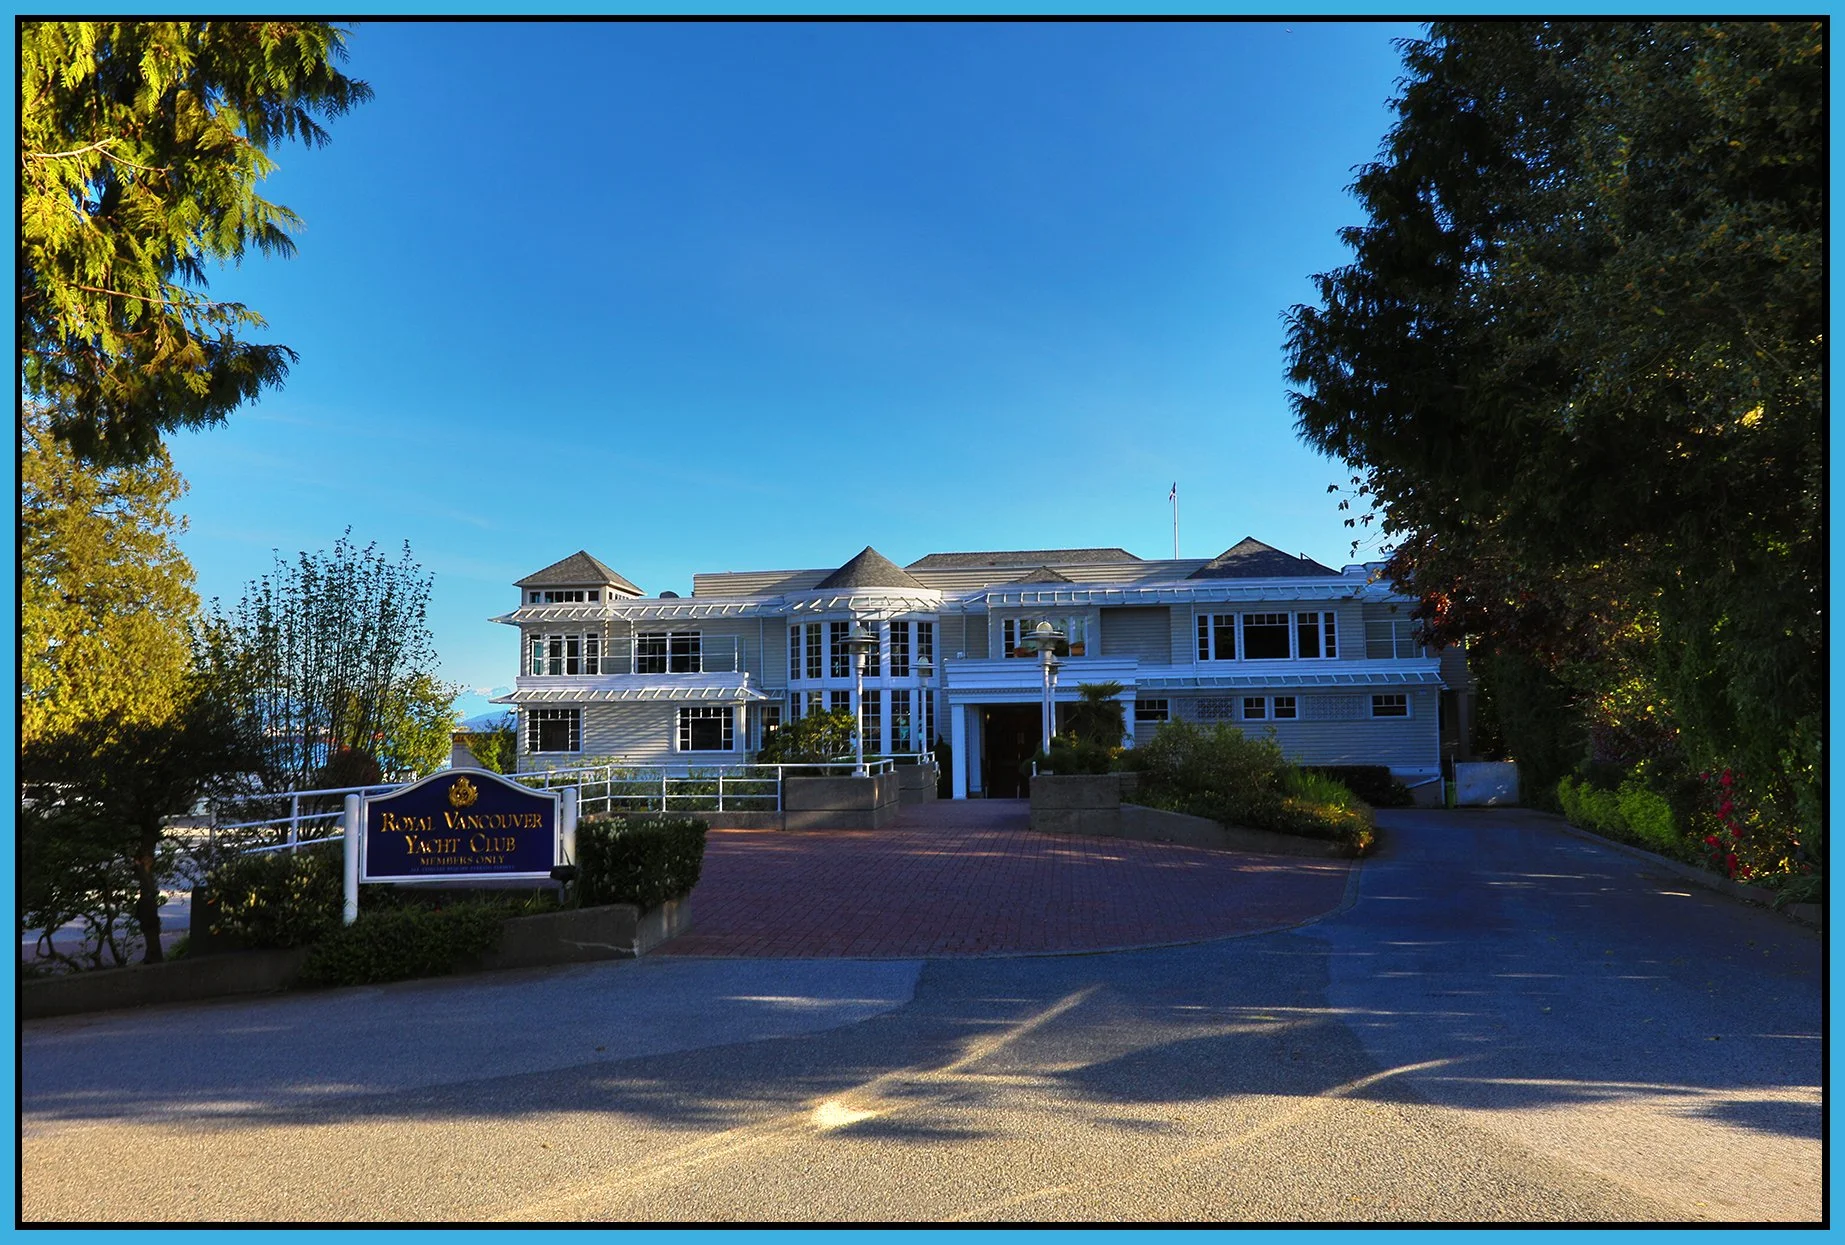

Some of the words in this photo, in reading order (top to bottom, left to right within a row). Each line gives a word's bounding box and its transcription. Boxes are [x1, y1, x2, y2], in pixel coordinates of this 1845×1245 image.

[380, 812, 436, 832] ROYAL
[444, 811, 543, 830] VANCOUVER
[405, 834, 461, 855] YACHT
[470, 833, 516, 853] CLUB
[420, 855, 473, 866] MEMBERS
[475, 855, 505, 864] ONLY
